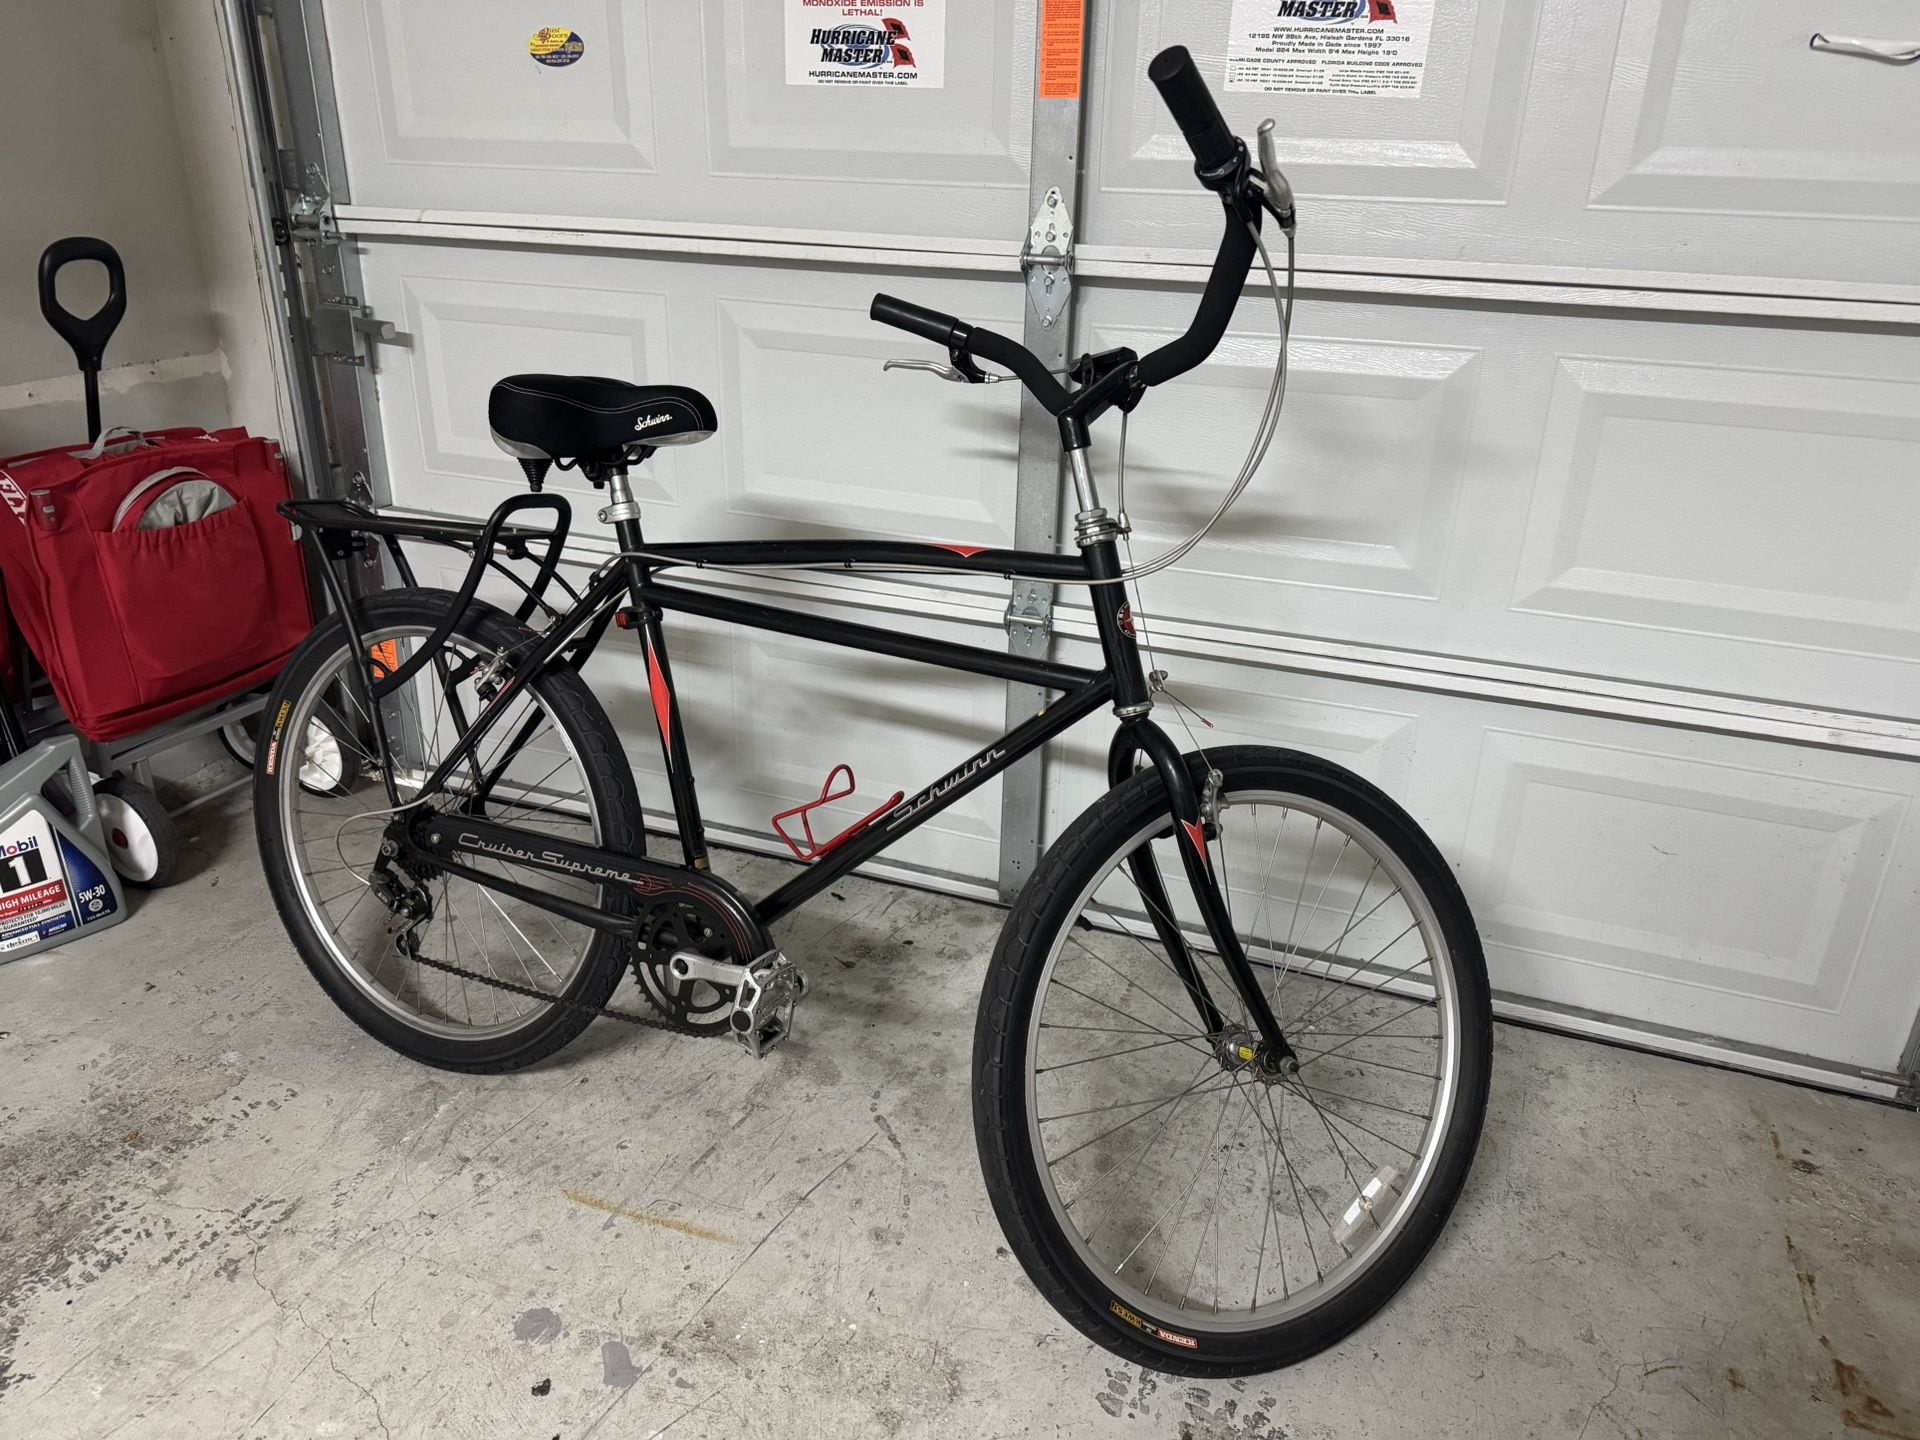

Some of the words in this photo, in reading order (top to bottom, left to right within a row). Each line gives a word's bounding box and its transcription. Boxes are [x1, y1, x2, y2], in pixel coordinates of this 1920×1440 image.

[1277, 0, 1358, 18] MASTER
[810, 29, 896, 45] HURRICANE
[1273, 26, 1384, 35] WWW.HURRICANEMASTER.COM
[1271, 40, 1297, 48] Proudly
[1357, 49, 1380, 57] Height
[820, 48, 883, 63] MASTER
[808, 70, 918, 80] HURRICANEMASTER.COM
[634, 413, 673, 431] Schwinn
[0, 478, 27, 526] FLY
[886, 748, 1007, 832] Schwinn
[459, 832, 536, 862] Cruiser
[536, 851, 644, 885] Supreme
[8, 855, 32, 886] 1
[20, 884, 62, 905] MILEAGE
[78, 883, 106, 904] 5W-30
